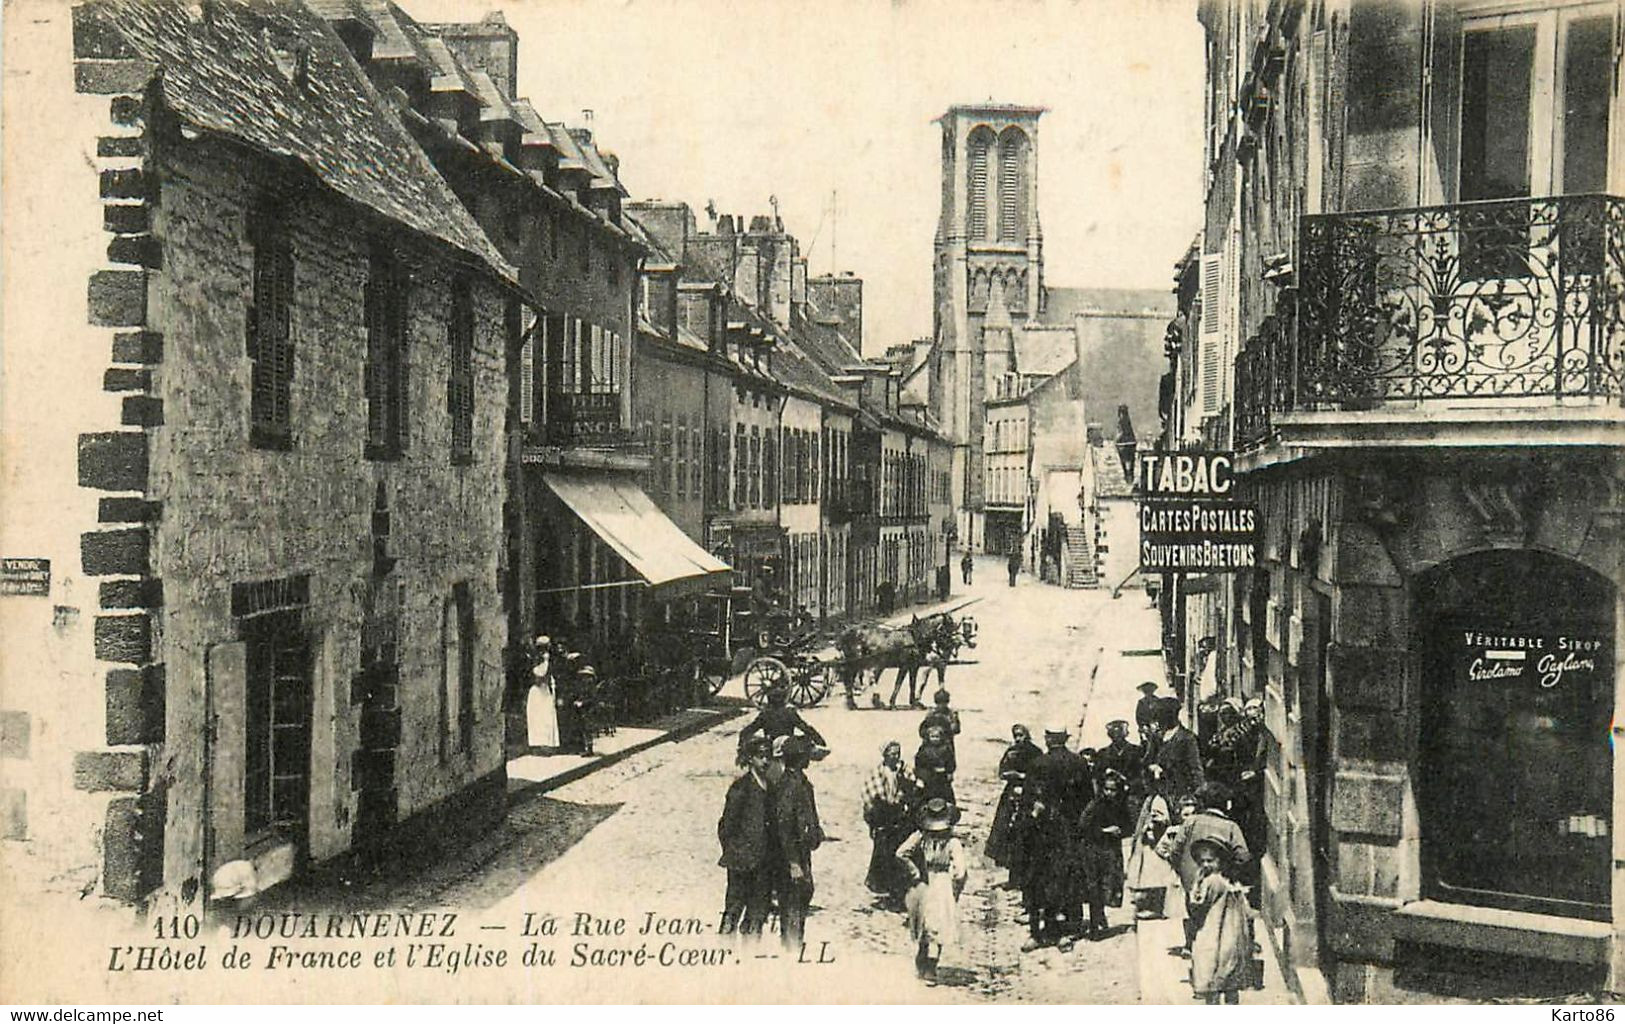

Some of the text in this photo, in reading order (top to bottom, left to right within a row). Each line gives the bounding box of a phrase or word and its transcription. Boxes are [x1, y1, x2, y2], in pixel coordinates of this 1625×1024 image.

[1142, 455, 1231, 493] TABAC
[1142, 505, 1255, 532] CARTES POSTALES
[1142, 540, 1255, 567] SOUVENIRS BRETONS
[1558, 636, 1601, 651] SIROP
